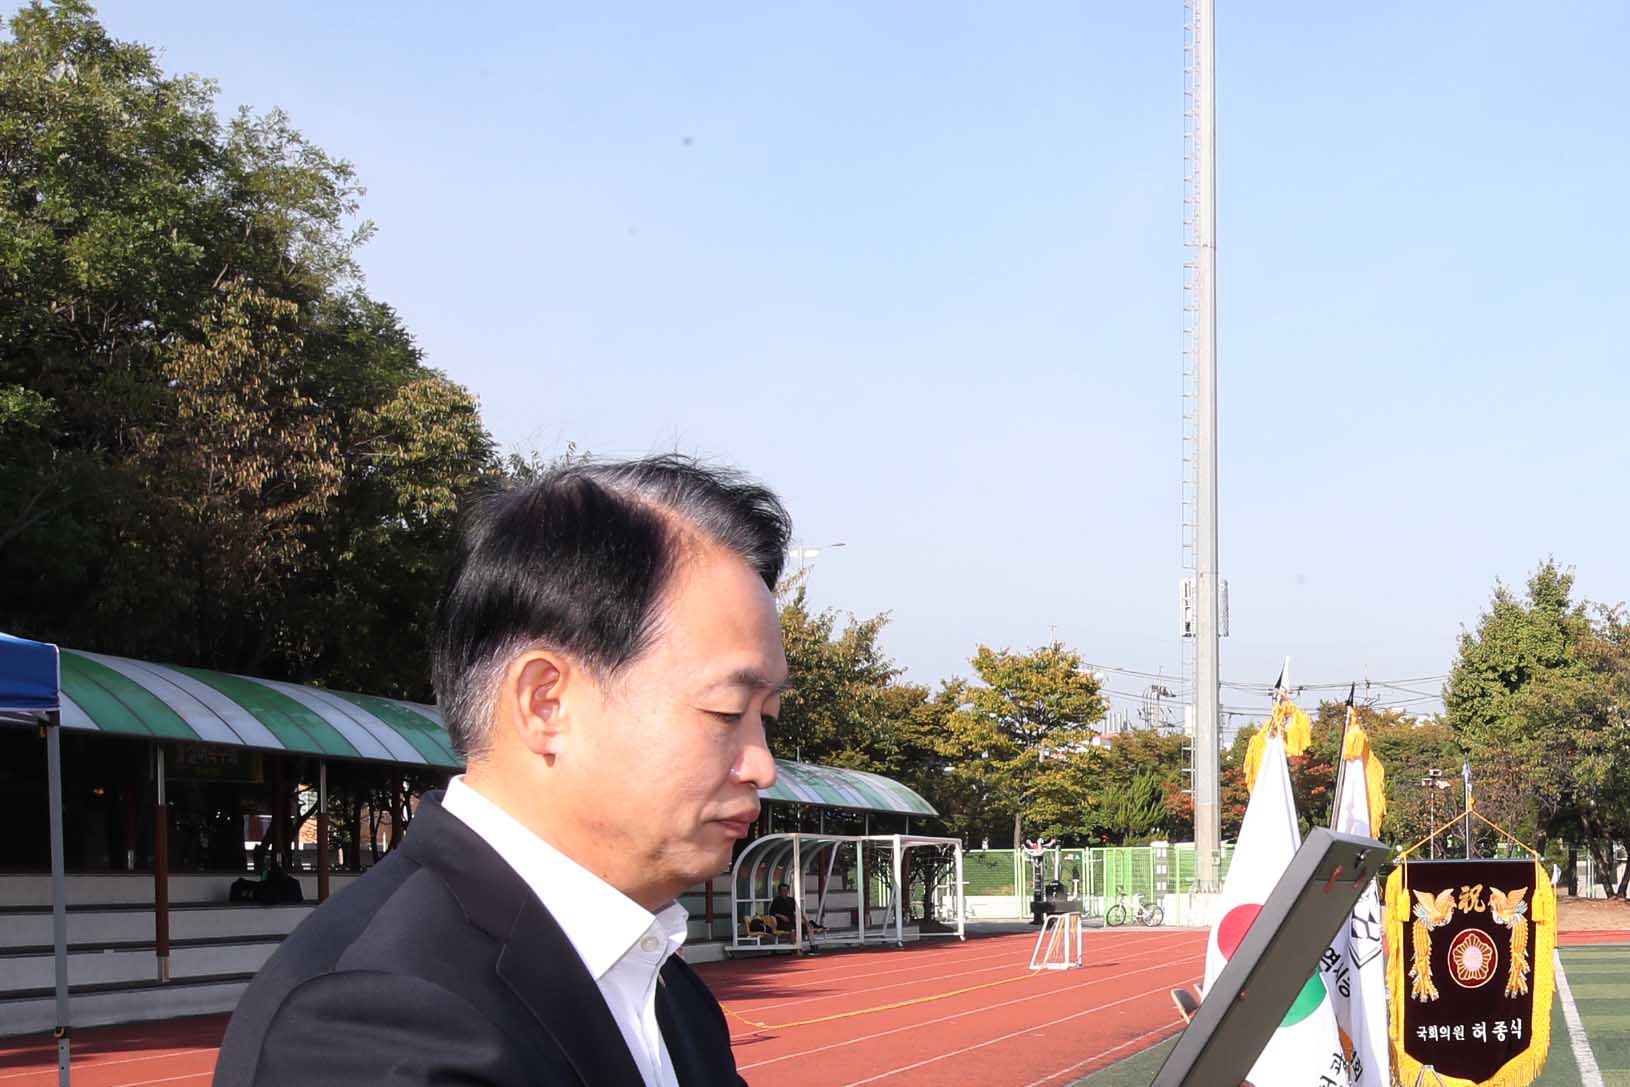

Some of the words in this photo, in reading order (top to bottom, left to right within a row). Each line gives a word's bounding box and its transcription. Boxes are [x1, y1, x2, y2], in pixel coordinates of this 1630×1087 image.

[1458, 884, 1486, 914] 祝
[1416, 1024, 1465, 1041] 국회의원
[1471, 1017, 1522, 1043] 허종식
